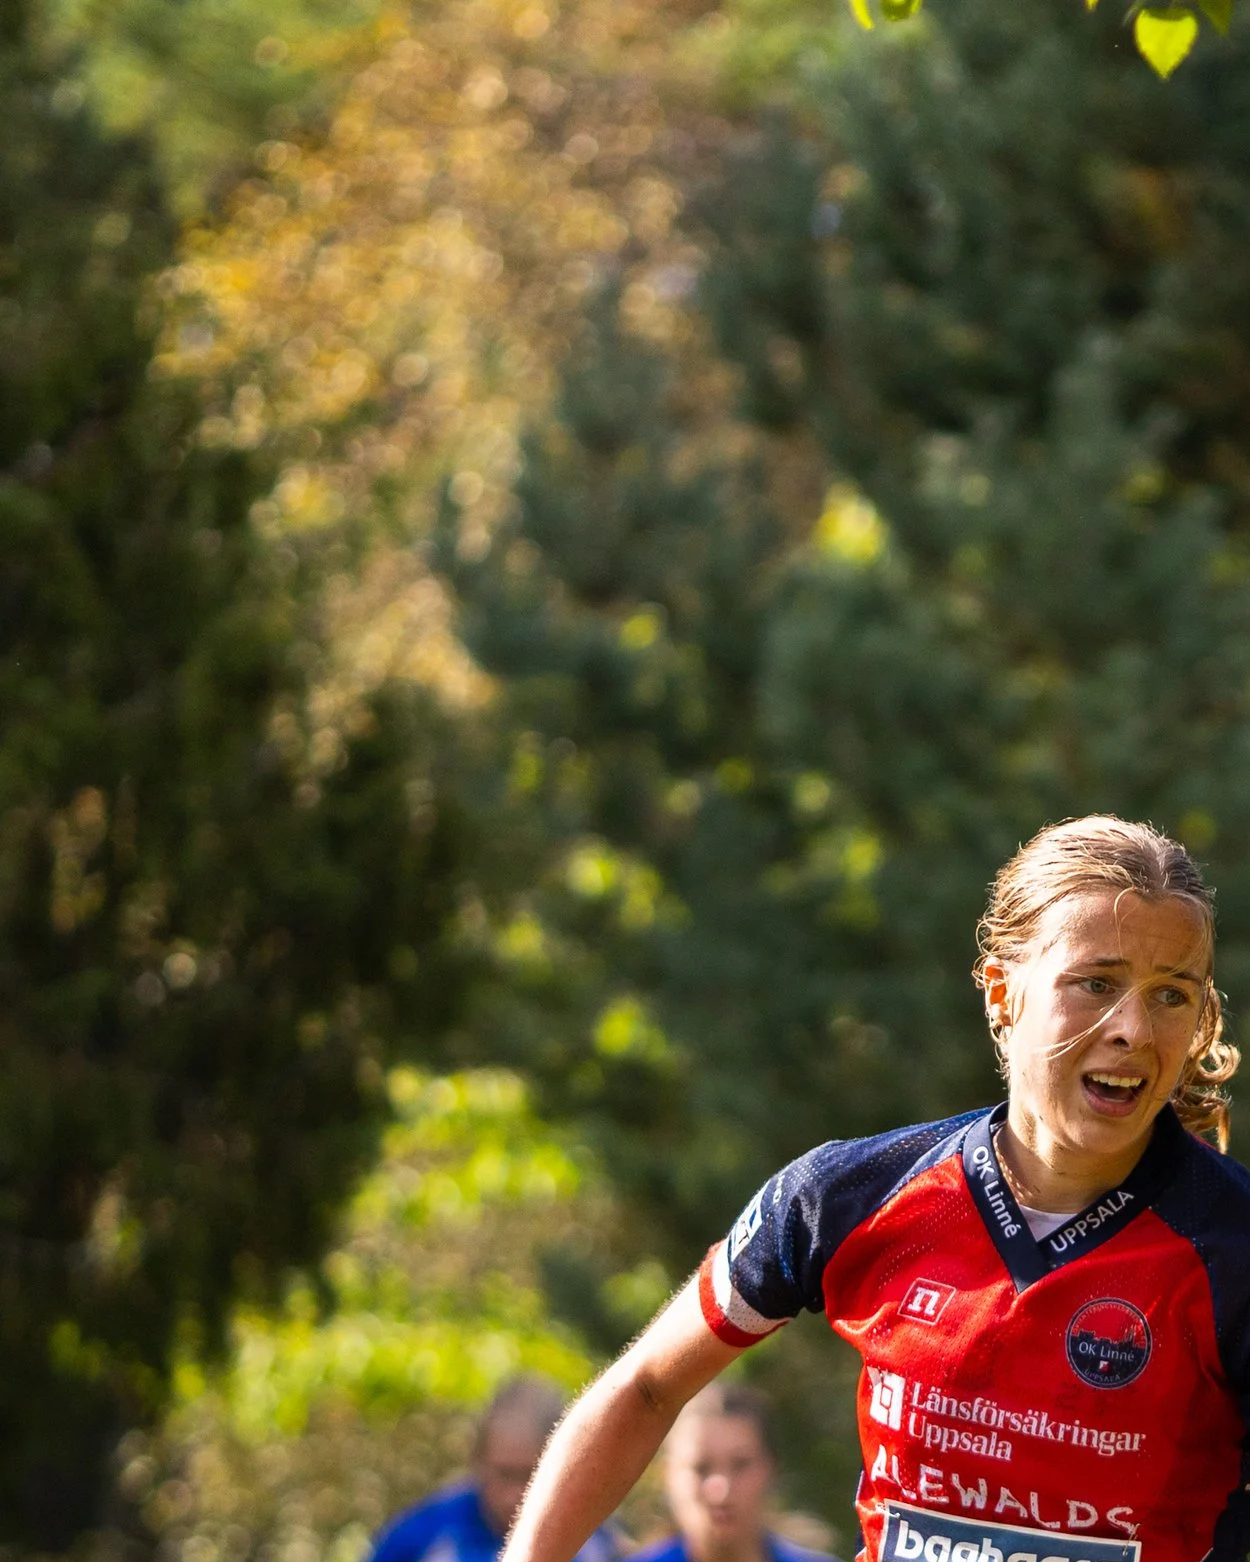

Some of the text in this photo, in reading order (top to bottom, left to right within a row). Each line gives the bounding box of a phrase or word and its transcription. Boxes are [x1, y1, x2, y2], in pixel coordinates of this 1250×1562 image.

[972, 1145, 1021, 1239] OK Linné
[1050, 1190, 1135, 1252] UPPSALA
[1078, 1341, 1135, 1361] OK Linné
[907, 1411, 1013, 1461] Uppsala
[910, 1382, 1147, 1456] Länsförsäkringar
